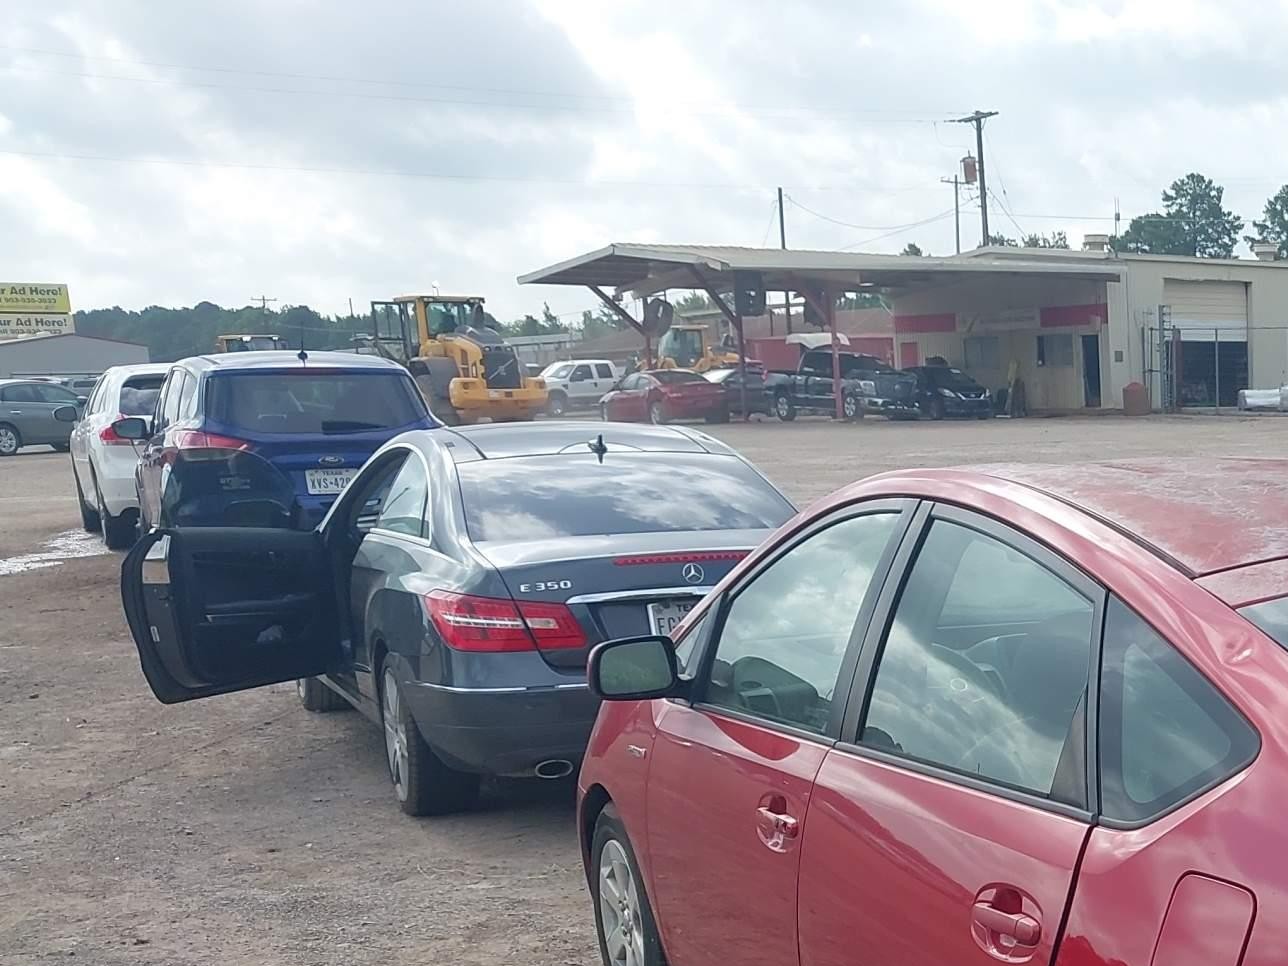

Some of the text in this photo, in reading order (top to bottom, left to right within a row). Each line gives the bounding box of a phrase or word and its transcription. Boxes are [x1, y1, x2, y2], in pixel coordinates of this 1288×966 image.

[10, 286, 26, 295] Ad
[29, 287, 62, 296] Here!
[16, 318, 32, 327] Ad
[34, 318, 68, 327] Here!
[520, 580, 572, 593] E 350
